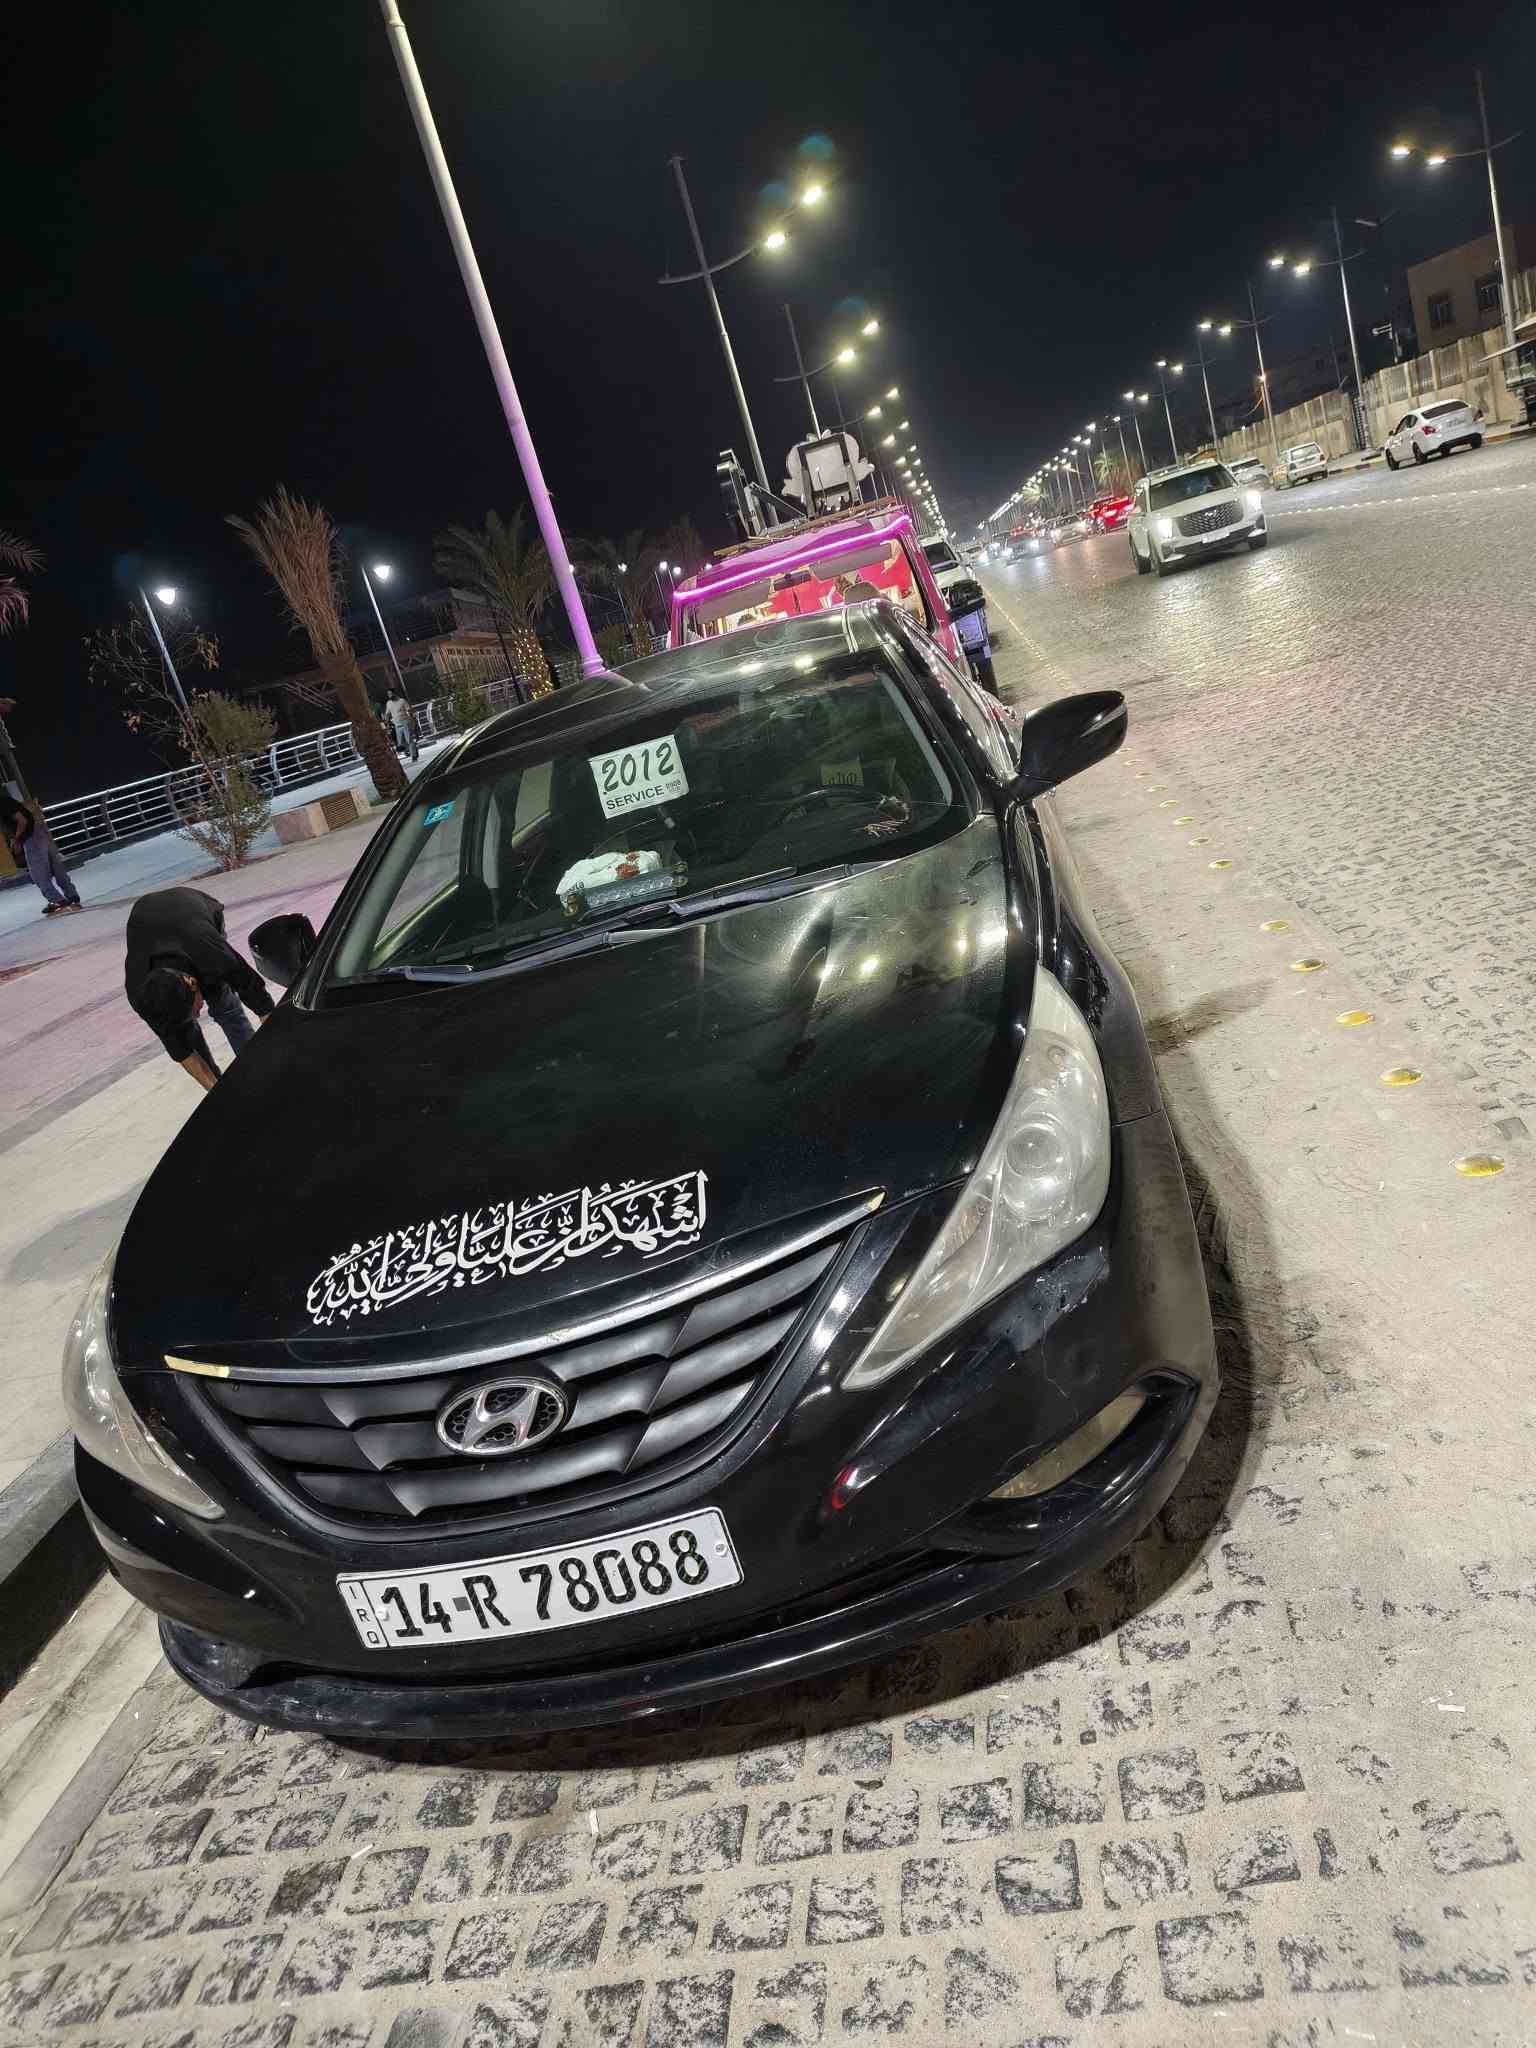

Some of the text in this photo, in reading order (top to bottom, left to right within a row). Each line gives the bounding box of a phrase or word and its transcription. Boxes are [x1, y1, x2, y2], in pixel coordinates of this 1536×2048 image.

[602, 742, 674, 793] 2012
[606, 785, 665, 810] SERVICE
[519, 1529, 709, 1620] 78088
